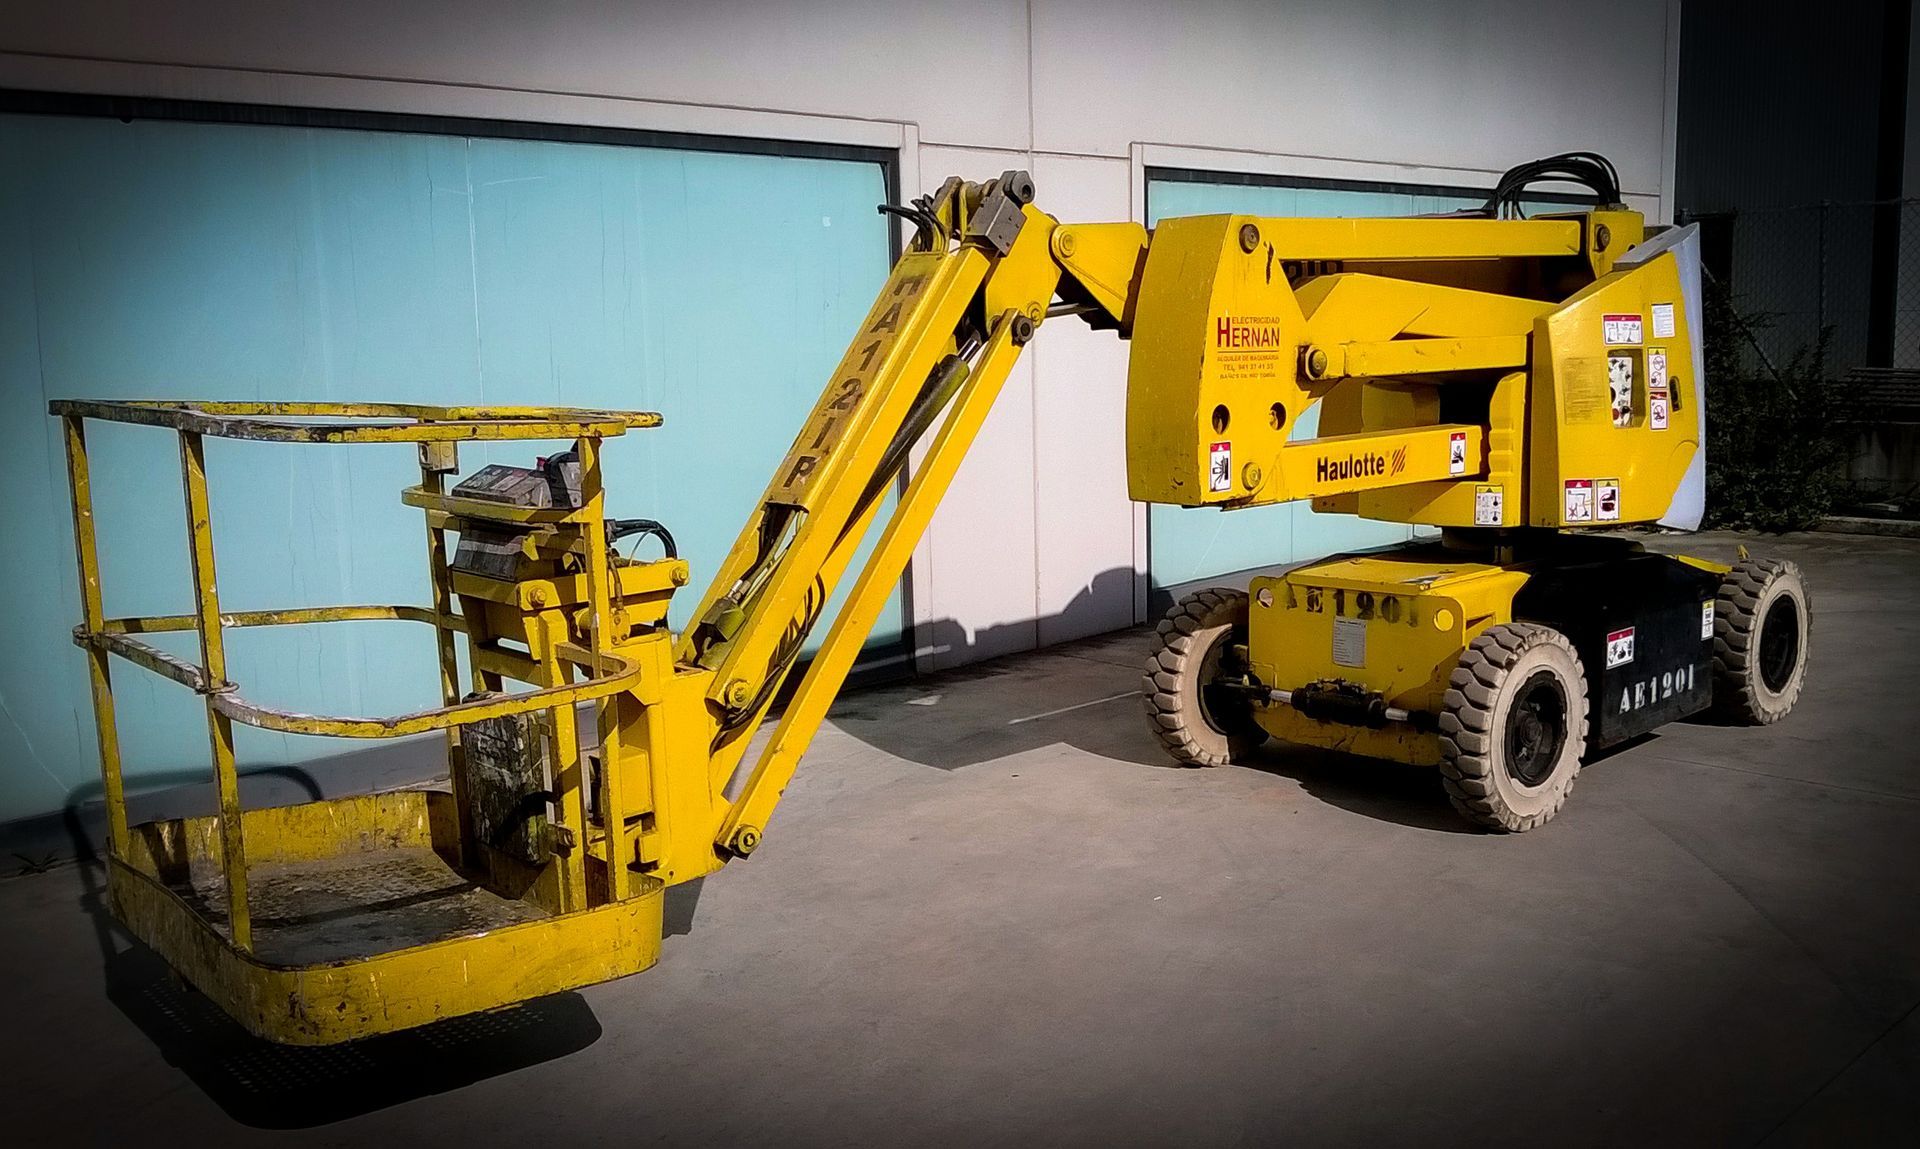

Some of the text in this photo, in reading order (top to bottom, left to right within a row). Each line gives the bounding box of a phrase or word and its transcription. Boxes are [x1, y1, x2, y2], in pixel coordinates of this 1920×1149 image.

[1217, 317, 1280, 348] HERNAN
[1232, 316, 1280, 324] ELECTRICIDAD
[1316, 451, 1386, 483] Haulotte
